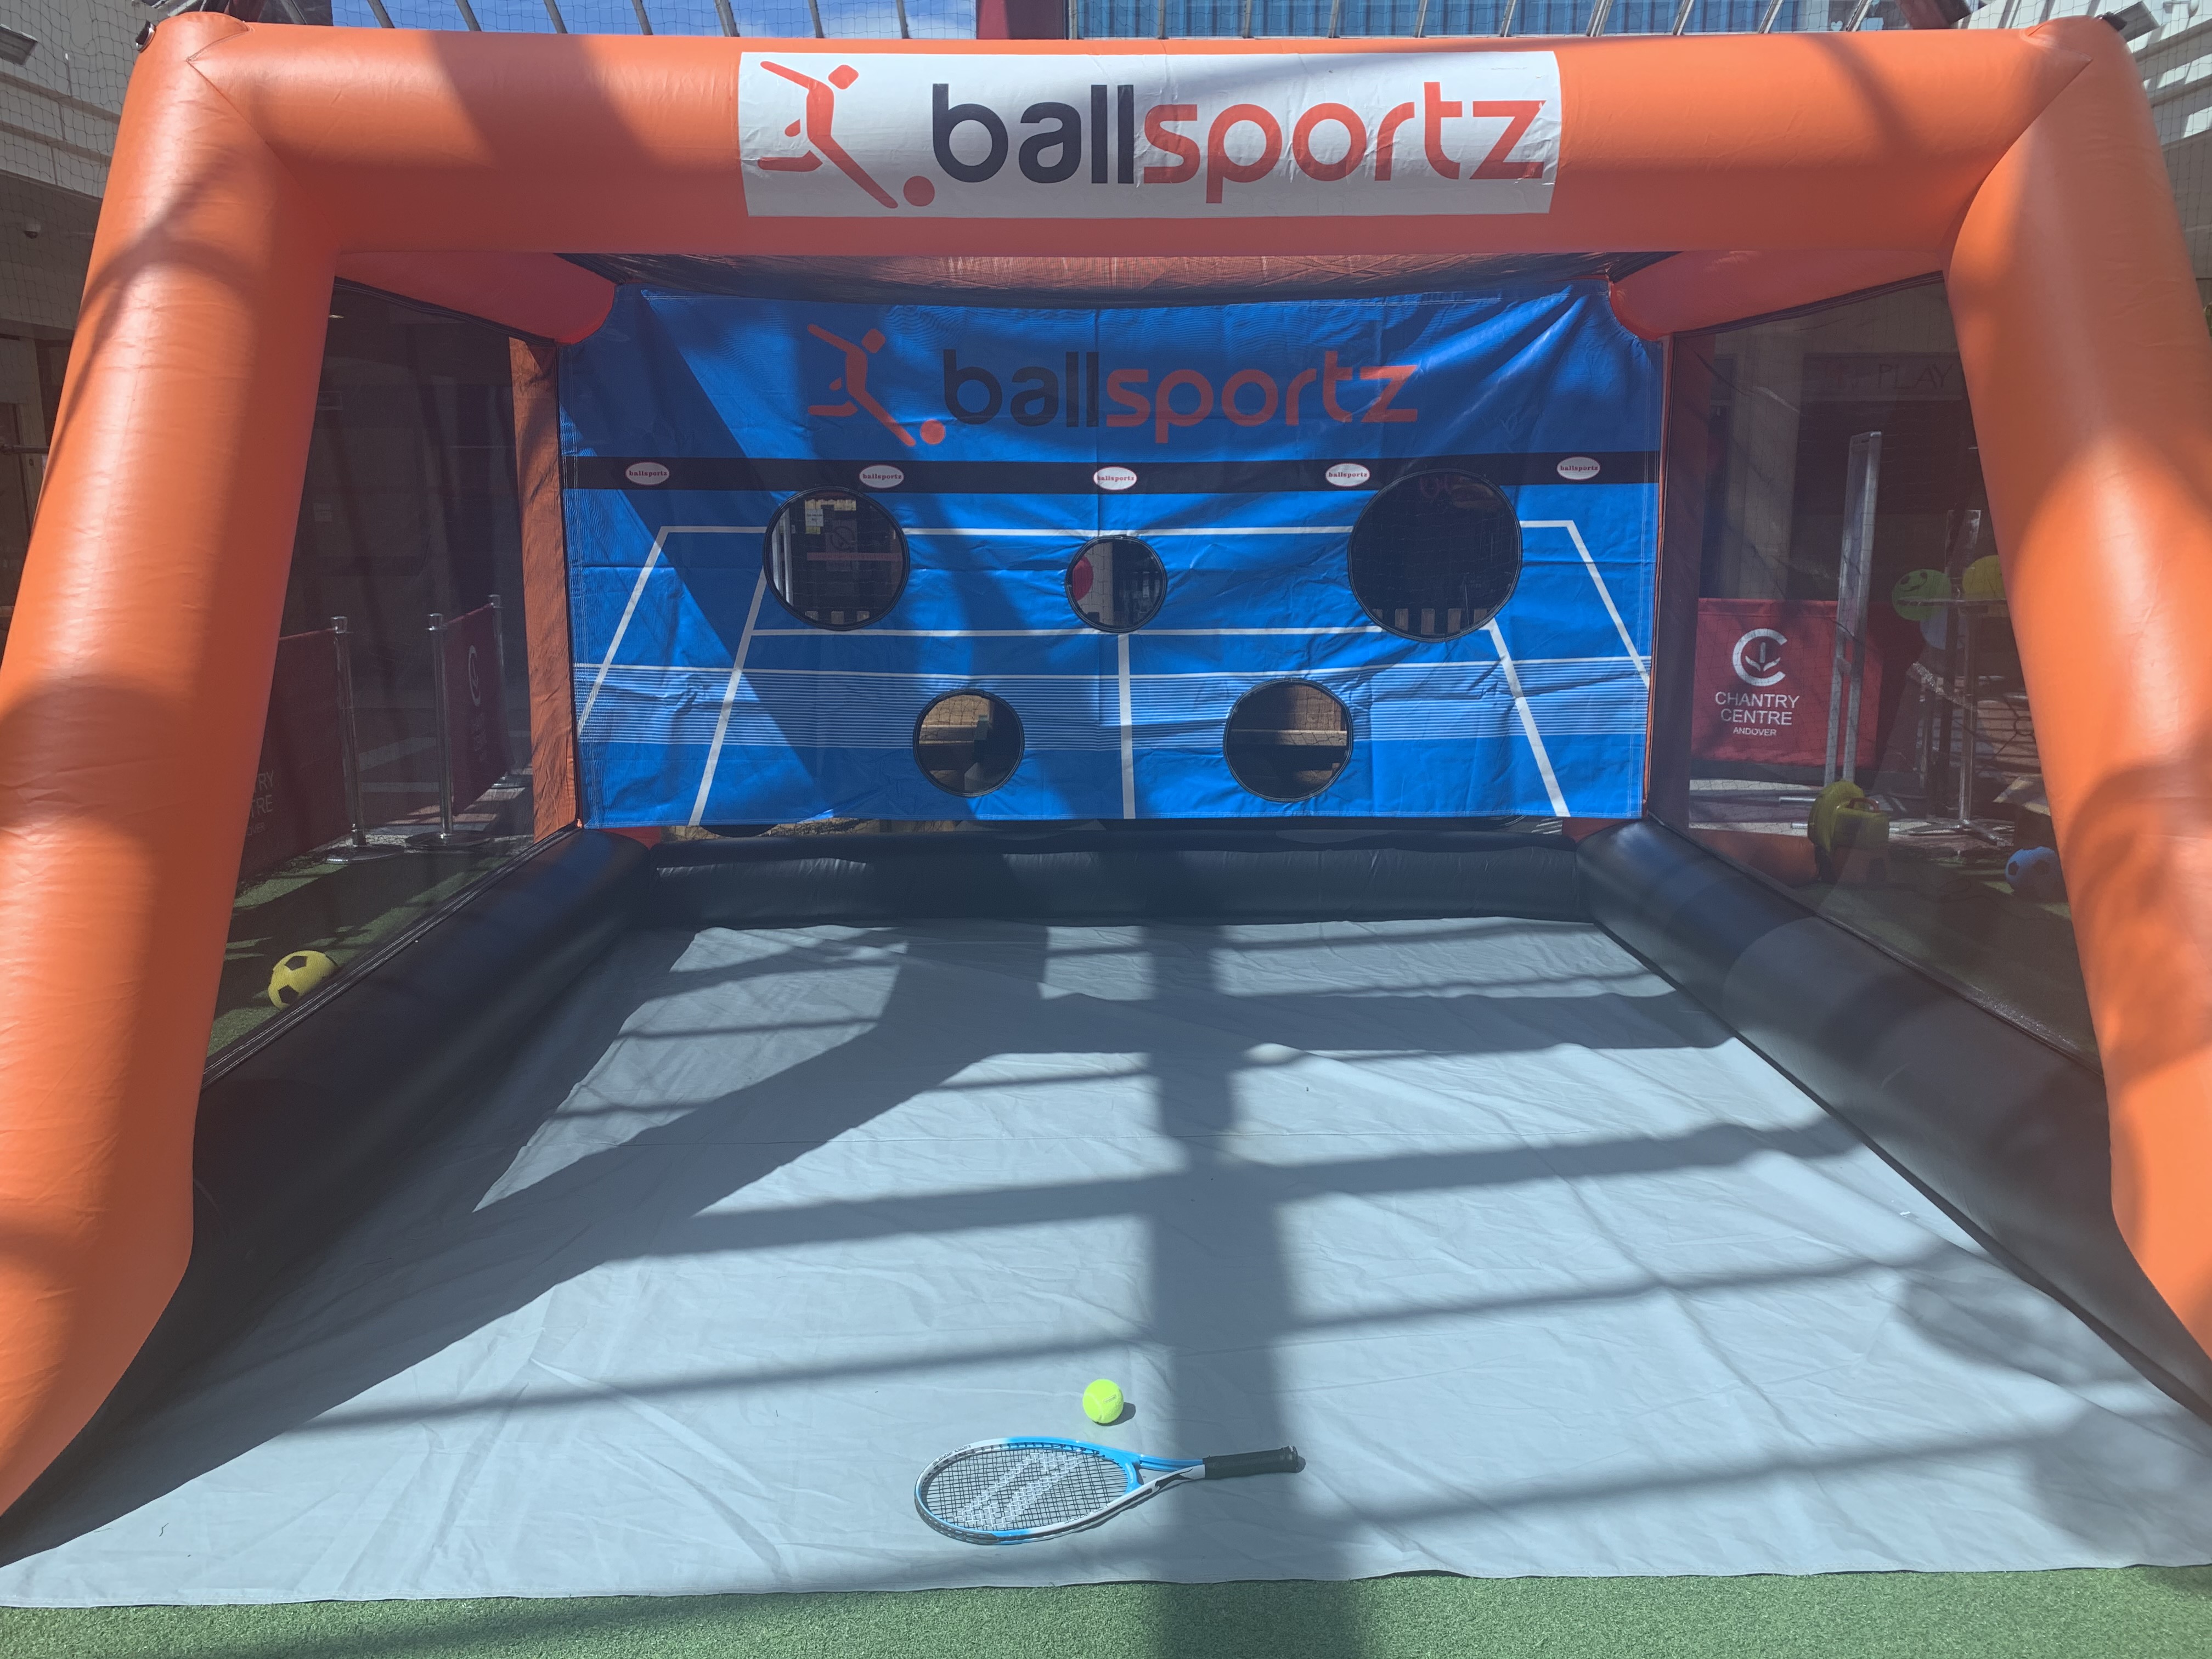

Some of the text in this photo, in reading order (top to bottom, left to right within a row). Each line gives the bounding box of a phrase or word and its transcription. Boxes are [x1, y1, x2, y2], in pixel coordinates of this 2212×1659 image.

[932, 81, 1545, 204] ballsportz
[943, 348, 1418, 443] ballsportz
[1715, 691, 1800, 708] CHANTRY
[1720, 708, 1793, 725] CENTRE
[1733, 726, 1777, 736] ANDOVER
